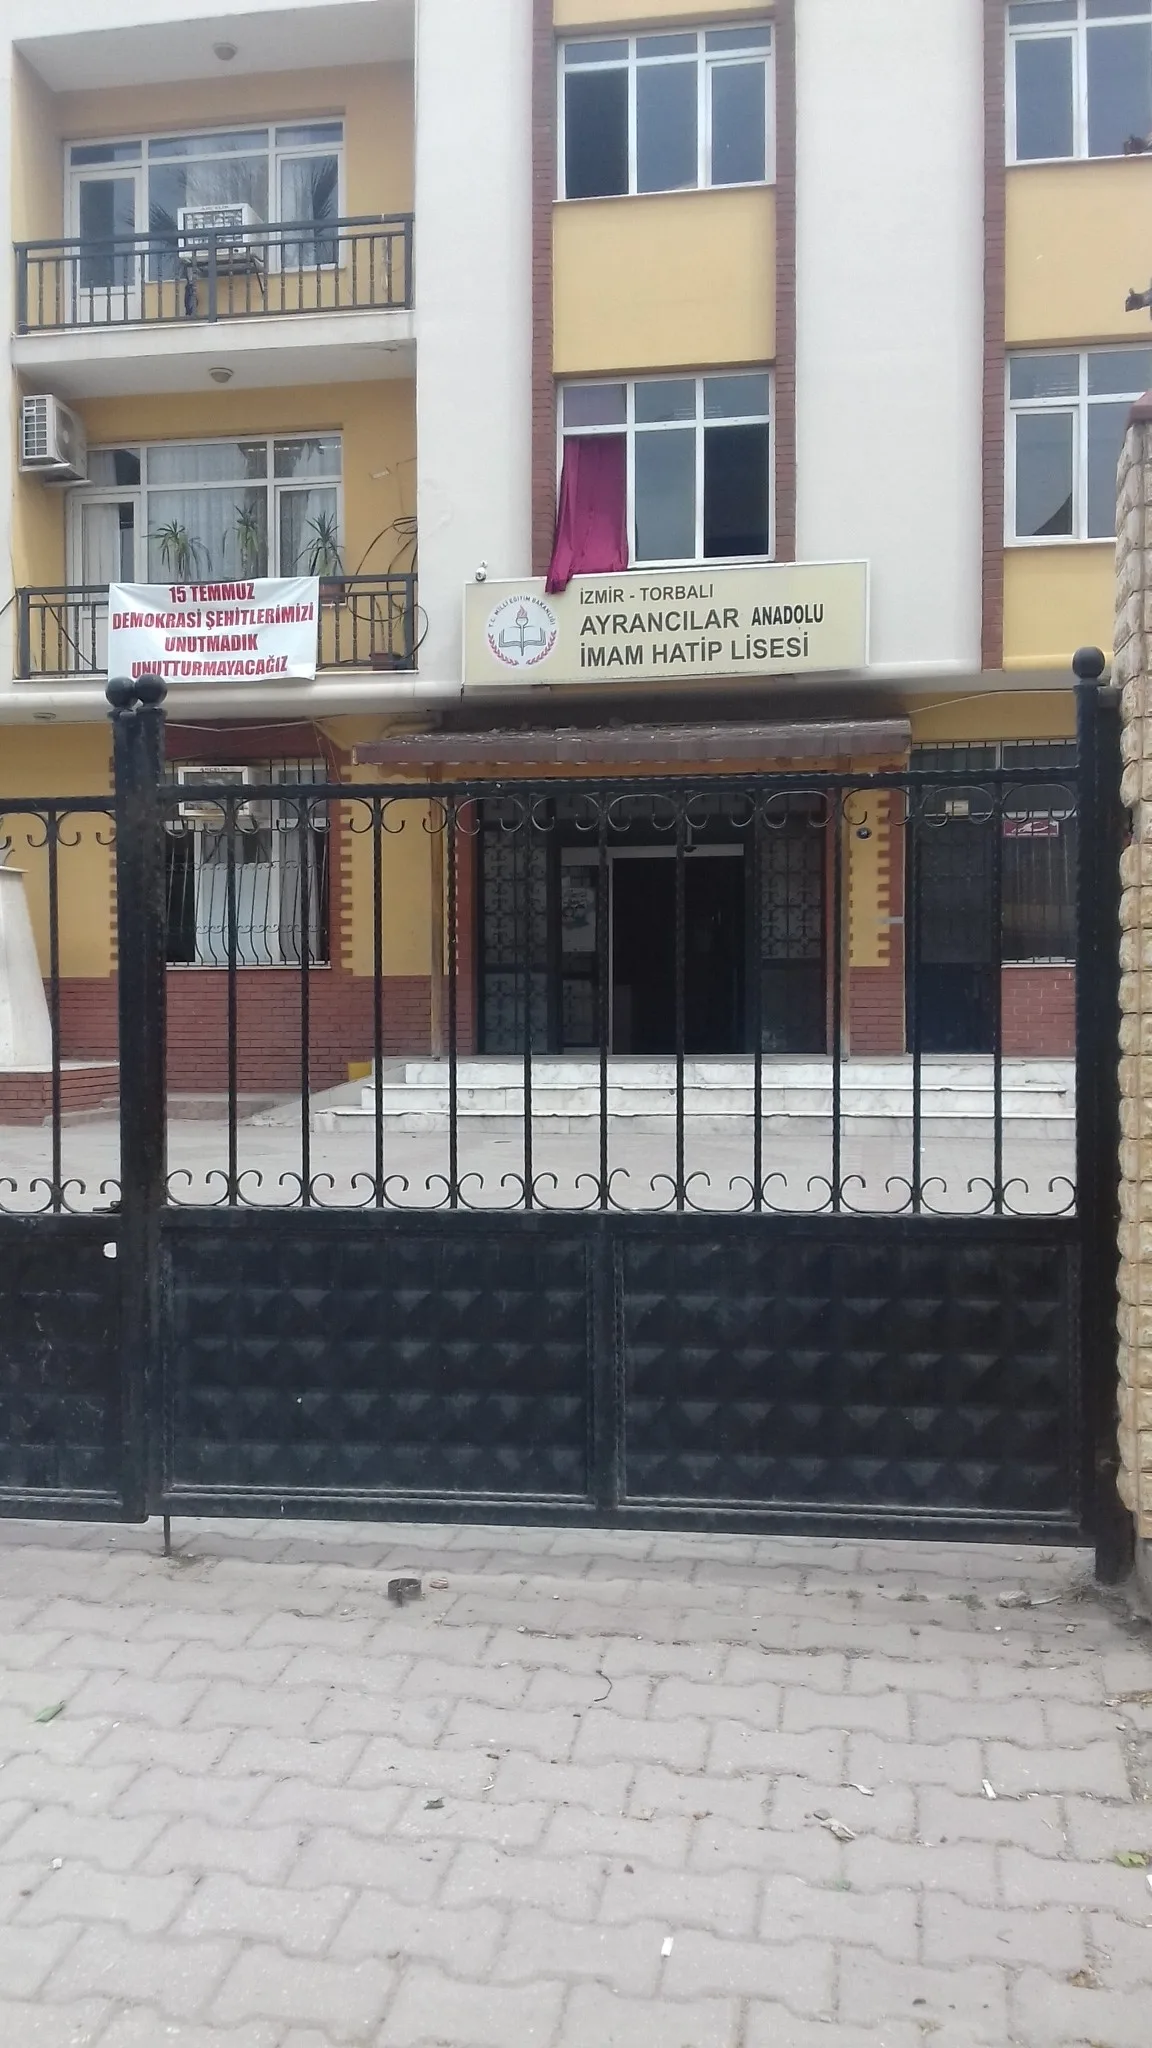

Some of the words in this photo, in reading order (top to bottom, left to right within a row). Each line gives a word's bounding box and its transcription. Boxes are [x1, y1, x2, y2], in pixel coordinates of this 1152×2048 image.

[169, 586, 187, 603] 15
[190, 582, 256, 601] TEMMUZ
[579, 585, 625, 604] İZMİR
[639, 584, 714, 602] TORBALI
[112, 608, 201, 630] DEMOKRASİ
[205, 602, 314, 630] ŞEHİTLERİMİZİ
[579, 607, 740, 636] AYRANCILAR
[751, 603, 824, 627] ANADOLU
[164, 633, 258, 653] UNUTMADIK
[580, 642, 644, 667] İMAM
[652, 636, 723, 664] HATİP
[731, 631, 809, 660] LİSESİ
[131, 654, 289, 679] UNUTTURMAYACAĞIZ
